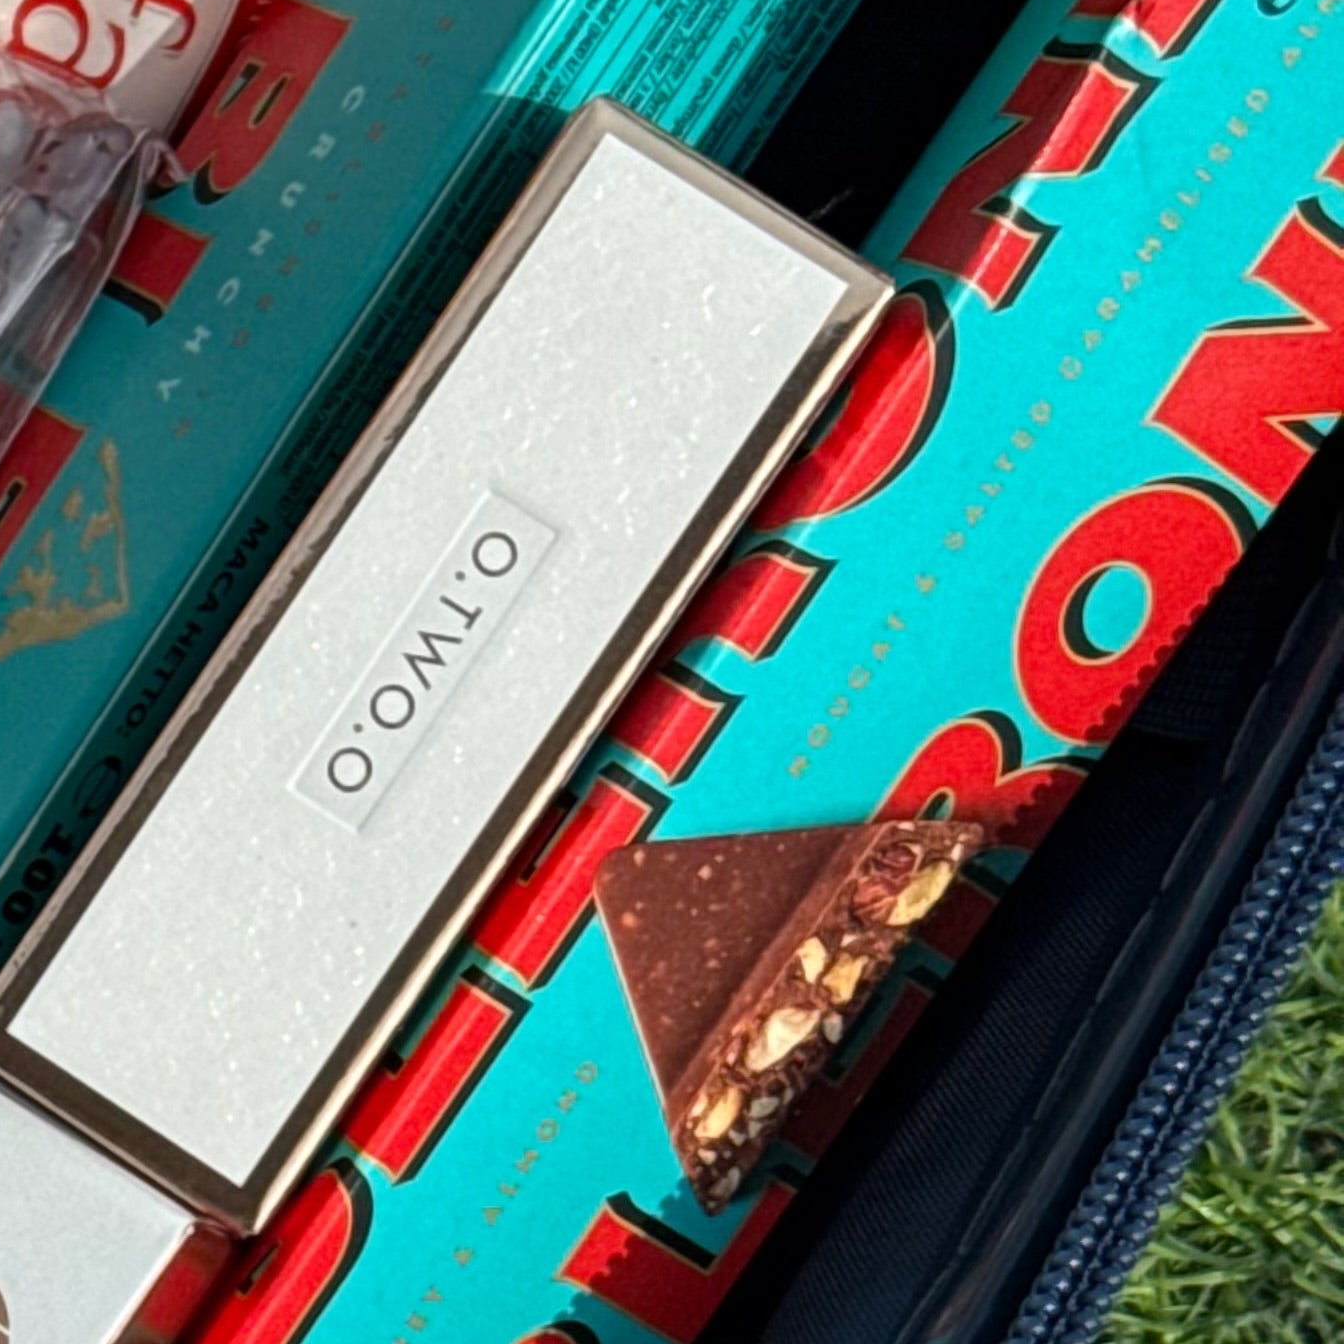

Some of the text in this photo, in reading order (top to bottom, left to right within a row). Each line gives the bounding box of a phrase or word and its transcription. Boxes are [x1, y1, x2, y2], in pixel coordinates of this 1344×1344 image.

[157, 85, 366, 403] CRUNCHY
[324, 529, 519, 796] O.TWO.O
[476, 1054, 604, 1228] ALMOND
